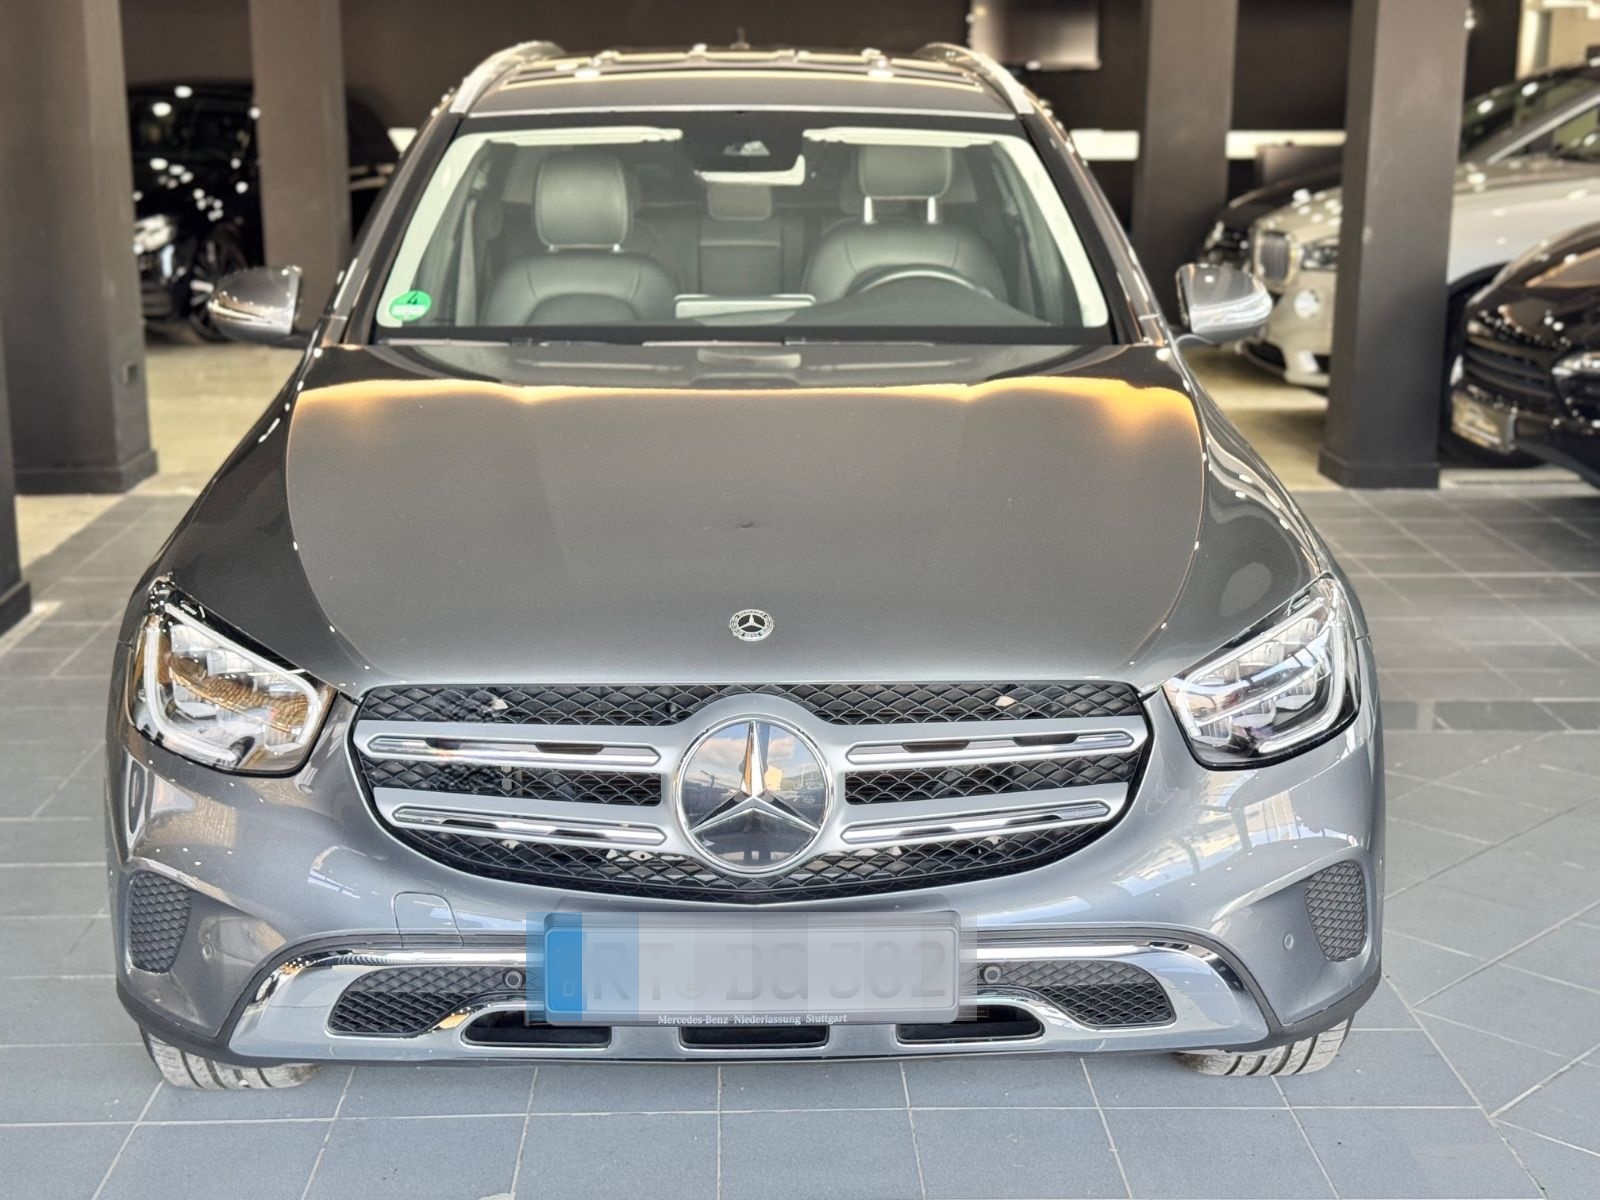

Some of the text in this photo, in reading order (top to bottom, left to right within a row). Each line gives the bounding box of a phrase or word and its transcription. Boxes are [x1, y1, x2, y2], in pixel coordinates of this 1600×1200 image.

[407, 292, 418, 305] 4
[657, 1013, 848, 1025] Mercedes-Benz Niederlassung Stuttgart
